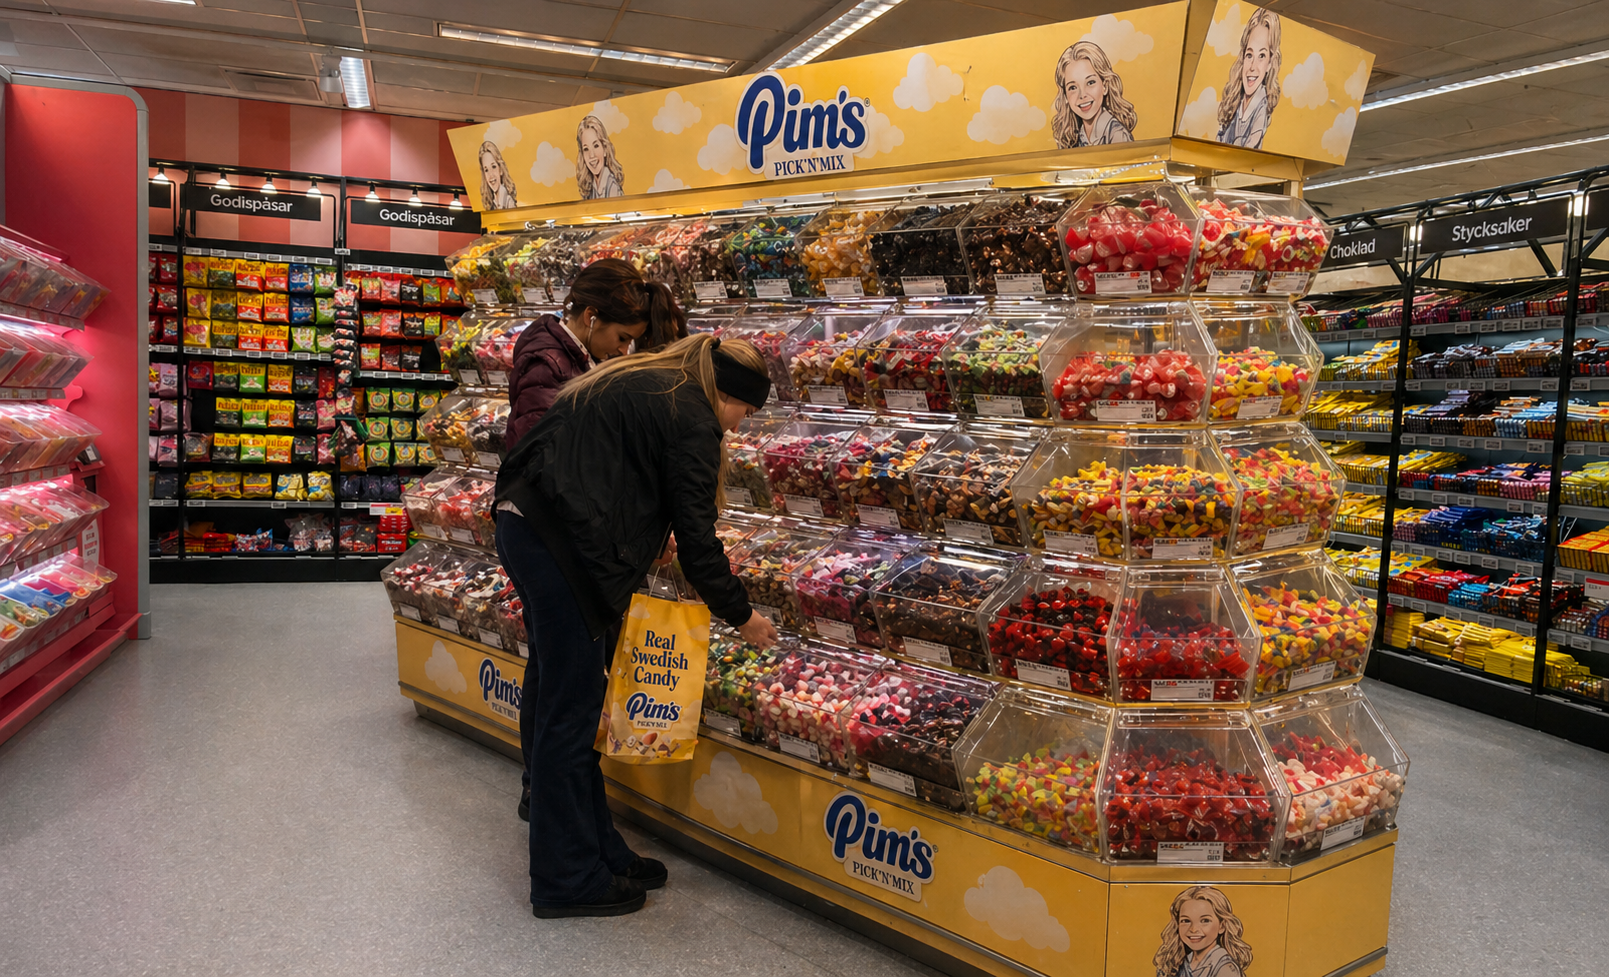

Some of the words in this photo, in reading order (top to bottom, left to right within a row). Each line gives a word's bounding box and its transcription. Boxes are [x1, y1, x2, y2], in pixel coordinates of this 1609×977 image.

[738, 74, 866, 169] Pim's
[774, 155, 846, 176] PICK'N'MIX
[210, 193, 293, 213] Godispåsar
[379, 208, 455, 226] Godispåsar
[1452, 216, 1533, 244] Stycksaker
[1330, 238, 1376, 259] Choklad
[644, 630, 676, 651] Real
[630, 646, 689, 670] Swedish
[634, 666, 680, 692] Candy
[626, 692, 681, 721] Pim's
[826, 794, 933, 880] Pim's
[852, 861, 915, 895] PICK'N'MIX
